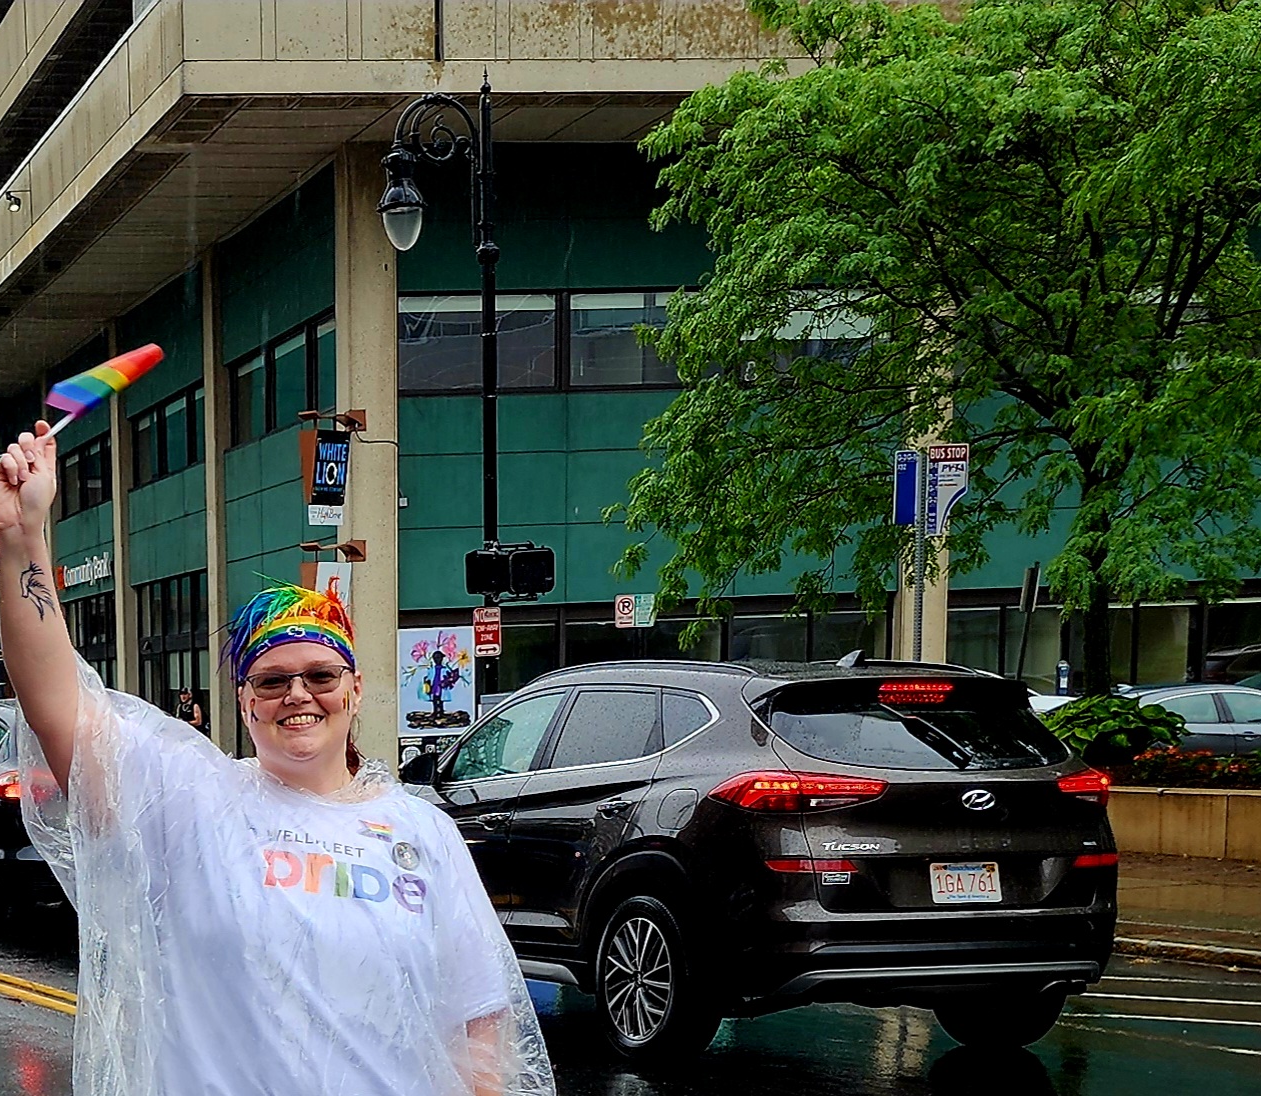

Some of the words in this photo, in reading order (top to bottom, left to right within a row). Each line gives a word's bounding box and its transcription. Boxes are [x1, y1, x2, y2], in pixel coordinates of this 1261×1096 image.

[319, 443, 348, 462] WHITE
[930, 448, 946, 460] BUS
[947, 447, 967, 459] STOP
[316, 462, 346, 485] LION
[822, 841, 880, 851] TUCSON
[936, 873, 965, 894] 1GA
[968, 872, 997, 892] 761
